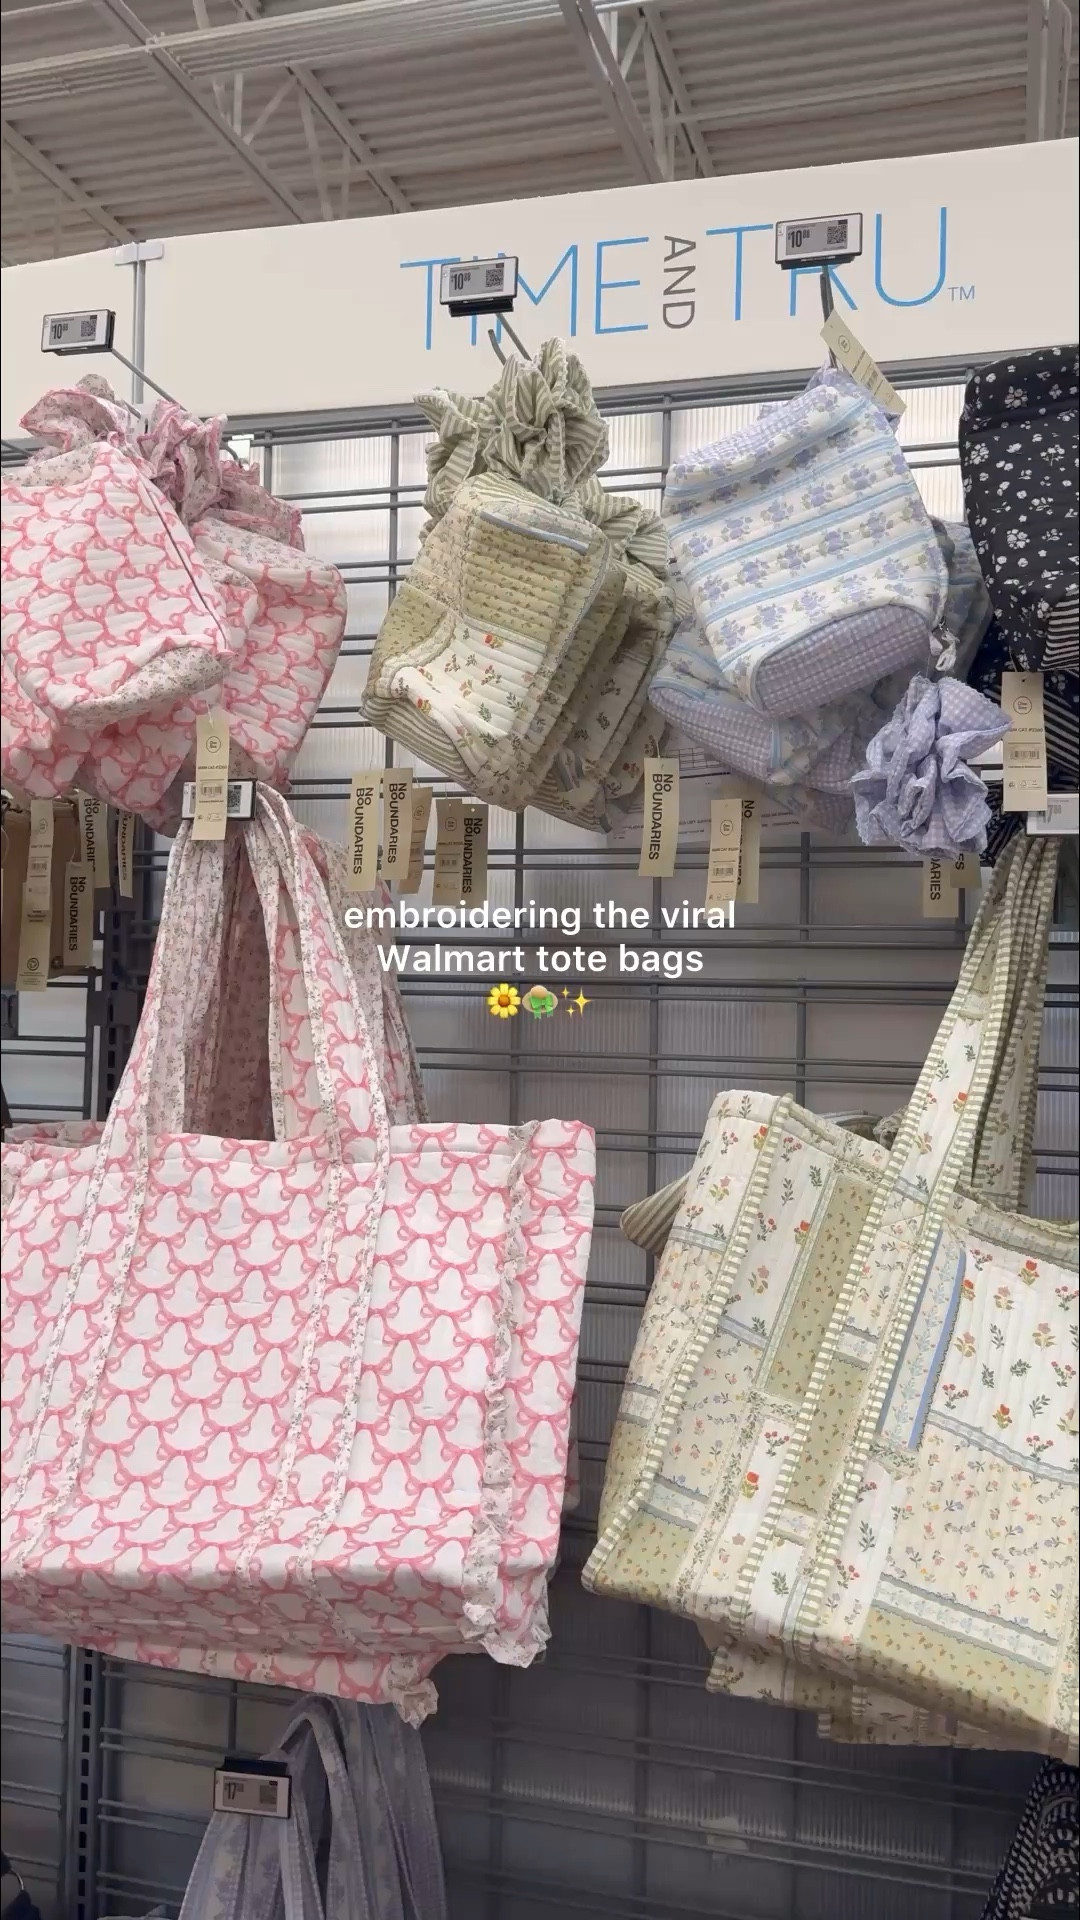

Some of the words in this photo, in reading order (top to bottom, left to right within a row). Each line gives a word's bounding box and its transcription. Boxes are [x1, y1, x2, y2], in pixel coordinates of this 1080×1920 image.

[663, 235, 696, 329] AND
[948, 285, 975, 301] TM
[397, 782, 407, 800] NO
[663, 773, 673, 792] NO
[91, 798, 100, 814] NO
[364, 787, 374, 806] NO
[648, 773, 663, 860] BOUNDARIES
[743, 800, 755, 819] NO
[353, 788, 365, 875] BOUNDARIES
[387, 783, 398, 864] BOUNDARIES
[473, 817, 483, 834] NO
[462, 817, 474, 894] BOUNDARIES
[78, 876, 87, 893] NO
[68, 876, 79, 952] BOUNDARIES
